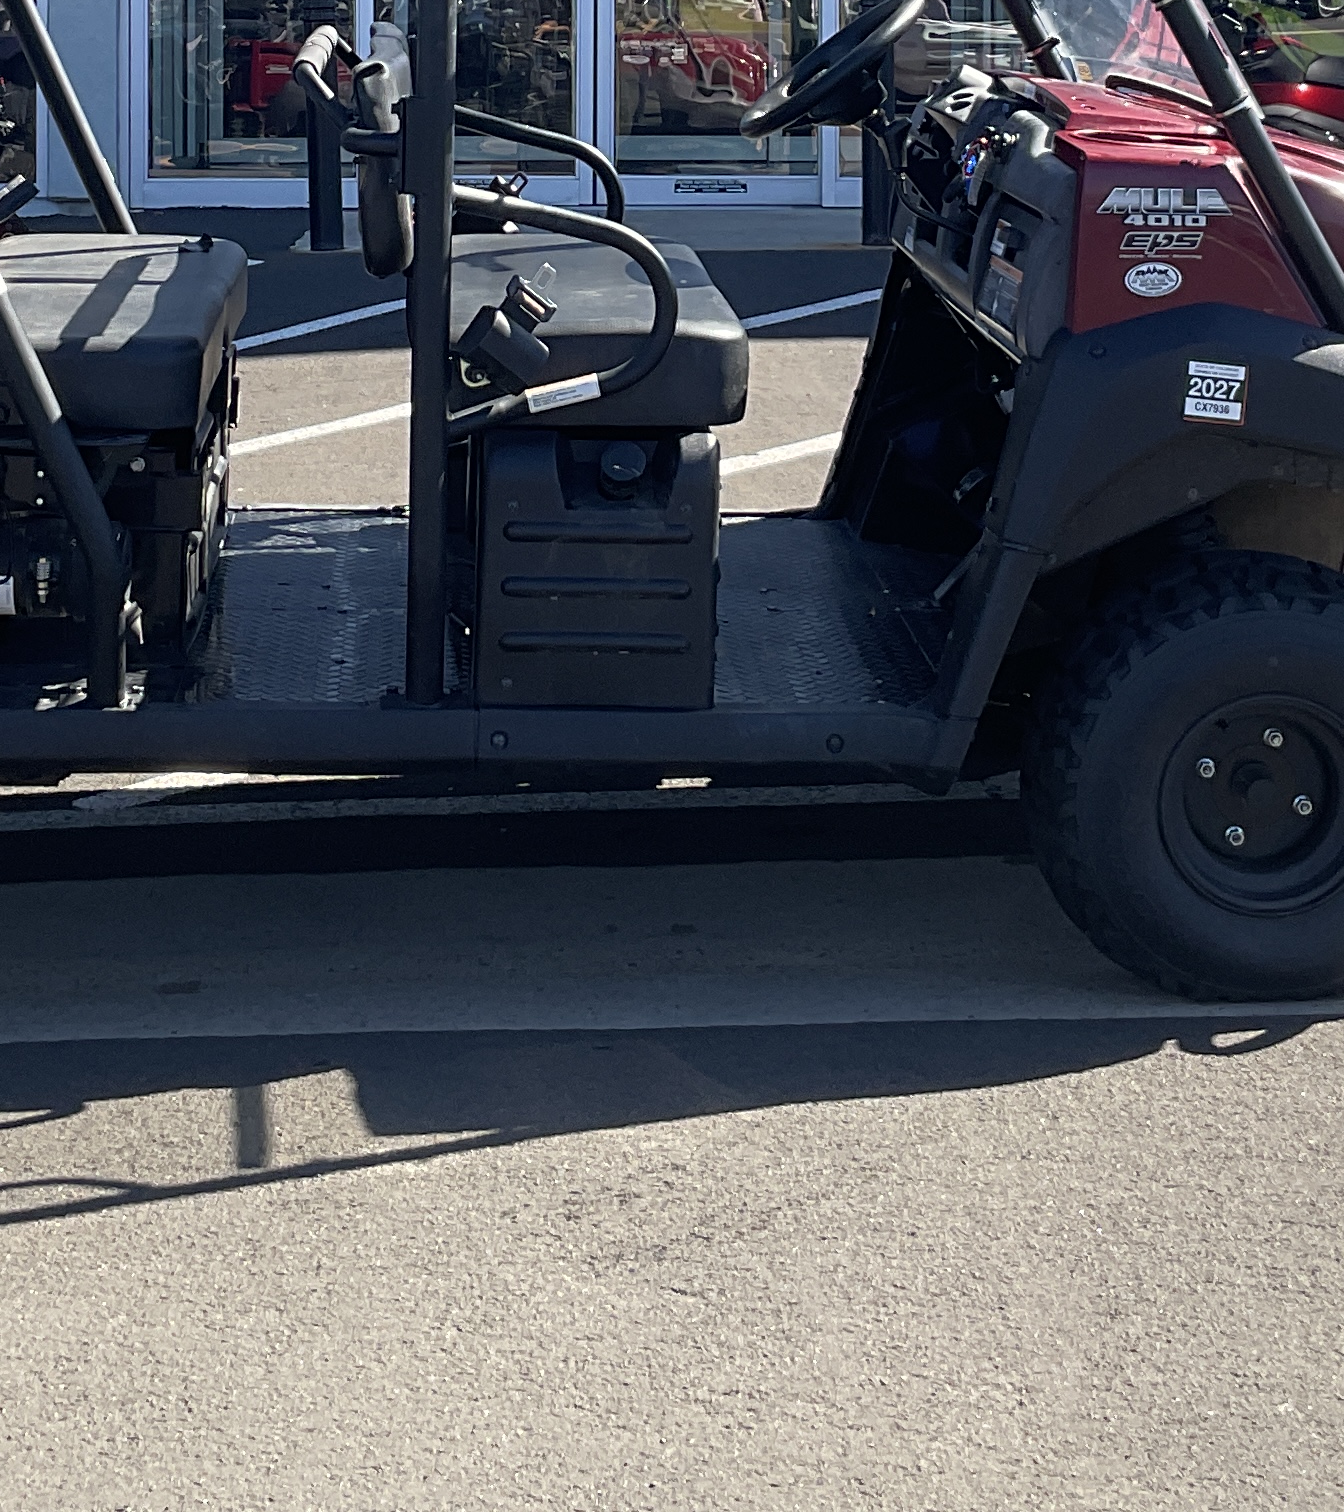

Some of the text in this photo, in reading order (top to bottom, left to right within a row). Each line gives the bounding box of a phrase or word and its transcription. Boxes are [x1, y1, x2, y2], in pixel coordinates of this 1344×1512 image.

[1096, 187, 1233, 216] MULE
[1123, 214, 1207, 226] 4010
[1188, 377, 1240, 400] 2027
